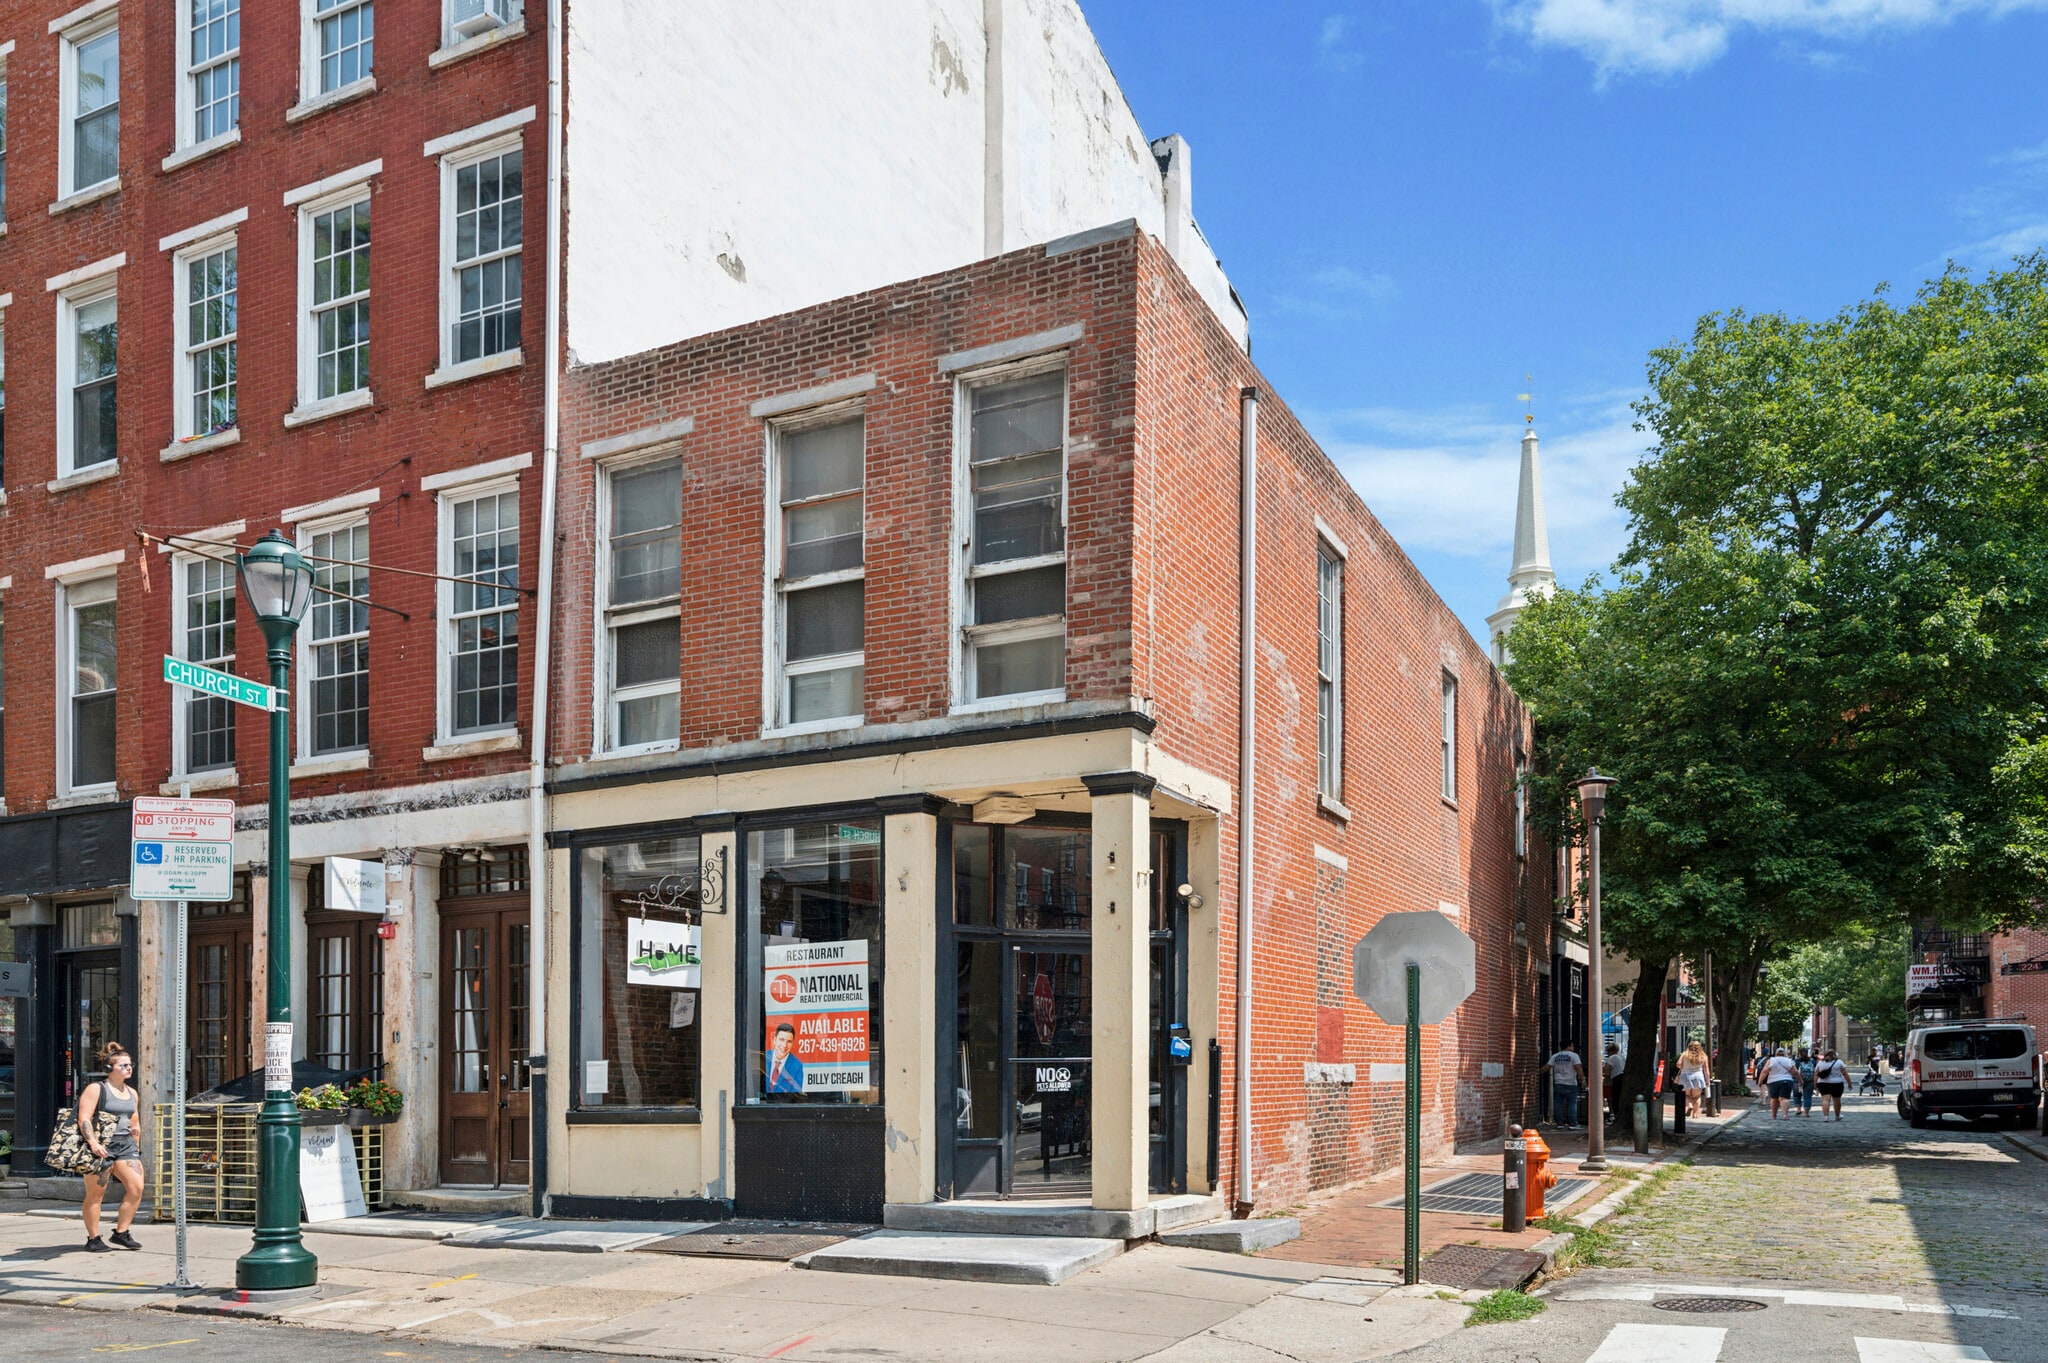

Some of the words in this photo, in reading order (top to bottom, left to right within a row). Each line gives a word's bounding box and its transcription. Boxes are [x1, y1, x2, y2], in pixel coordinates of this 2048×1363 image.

[168, 662, 240, 698] CHURCH
[246, 689, 261, 704] ST
[136, 816, 153, 825] NO
[157, 816, 215, 826] STOPPING
[175, 846, 217, 854] RESERVED
[164, 855, 170, 863] 2
[174, 855, 185, 863] HR
[190, 855, 227, 864] PARKING
[786, 946, 845, 962] RESTAURANT
[2021, 963, 2039, 971] 224
[800, 973, 864, 993] NATIONAL
[800, 994, 823, 1004] REALTY
[823, 993, 864, 1003] COMMERCIAL
[266, 1025, 291, 1034] OPPING
[799, 1017, 865, 1035] AVAILABLE
[798, 1037, 865, 1054] 267-439-6926
[266, 1067, 289, 1075] LATION
[1036, 1067, 1056, 1083] NO
[1928, 1070, 1974, 1080] WM.PROUD
[807, 1073, 830, 1085] BILLY
[830, 1072, 864, 1085] CREAGH
